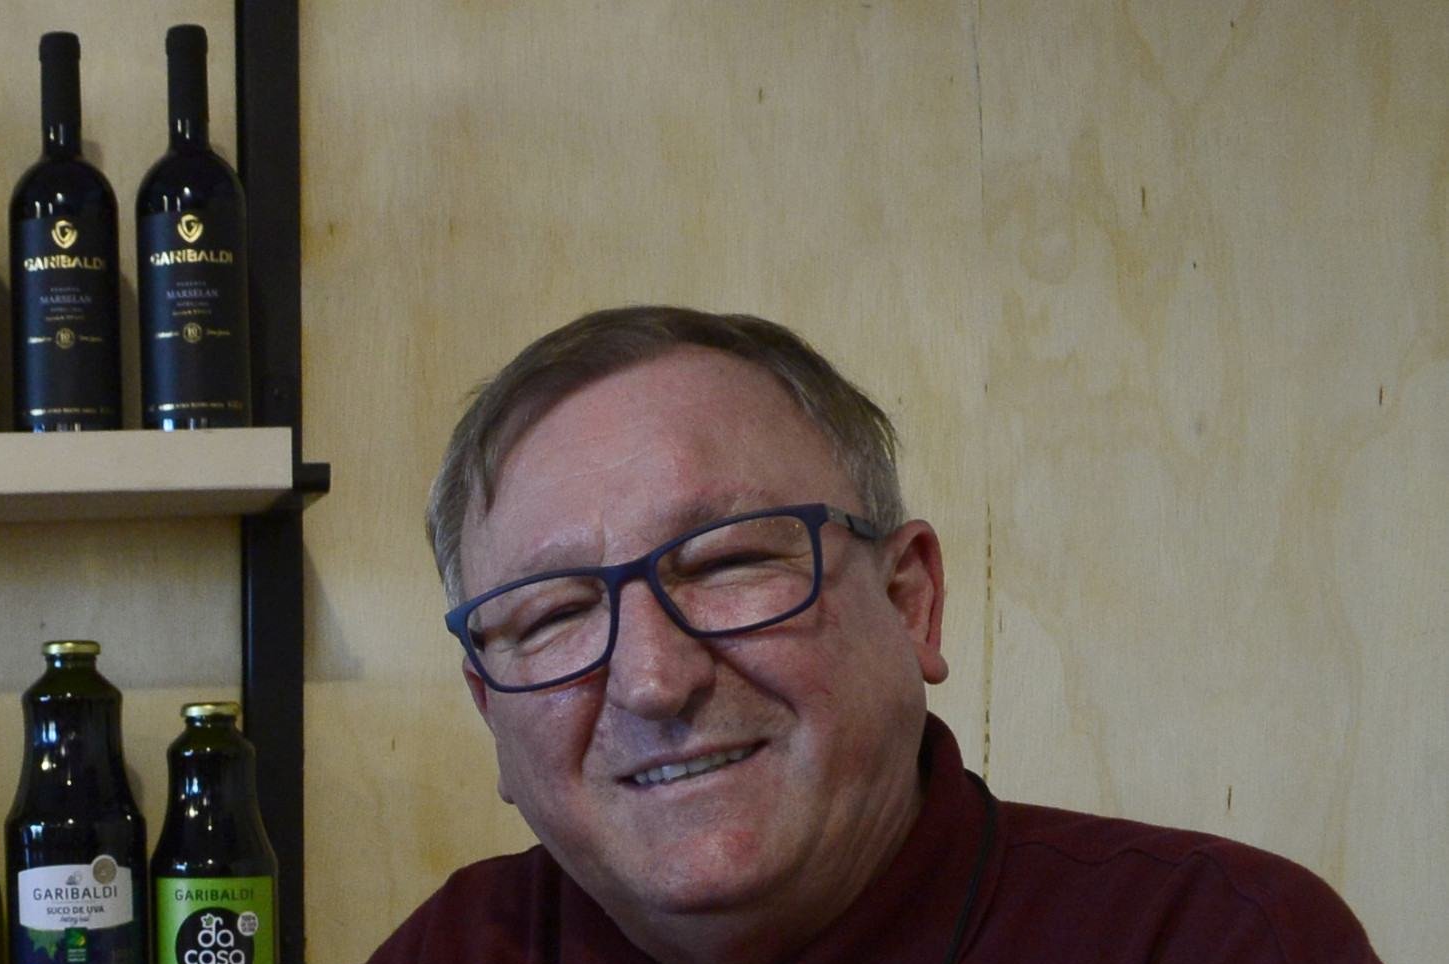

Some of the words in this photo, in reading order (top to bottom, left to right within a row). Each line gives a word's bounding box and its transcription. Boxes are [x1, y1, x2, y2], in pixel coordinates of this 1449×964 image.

[24, 255, 104, 272] GARIBALDI
[150, 249, 233, 266] GARIBALDI
[33, 886, 117, 901] GARIBALDI
[175, 888, 254, 901] GARIBALDI
[47, 906, 70, 915] SUCO
[72, 906, 85, 914] DE
[86, 905, 105, 914] UVA
[198, 914, 234, 947] da
